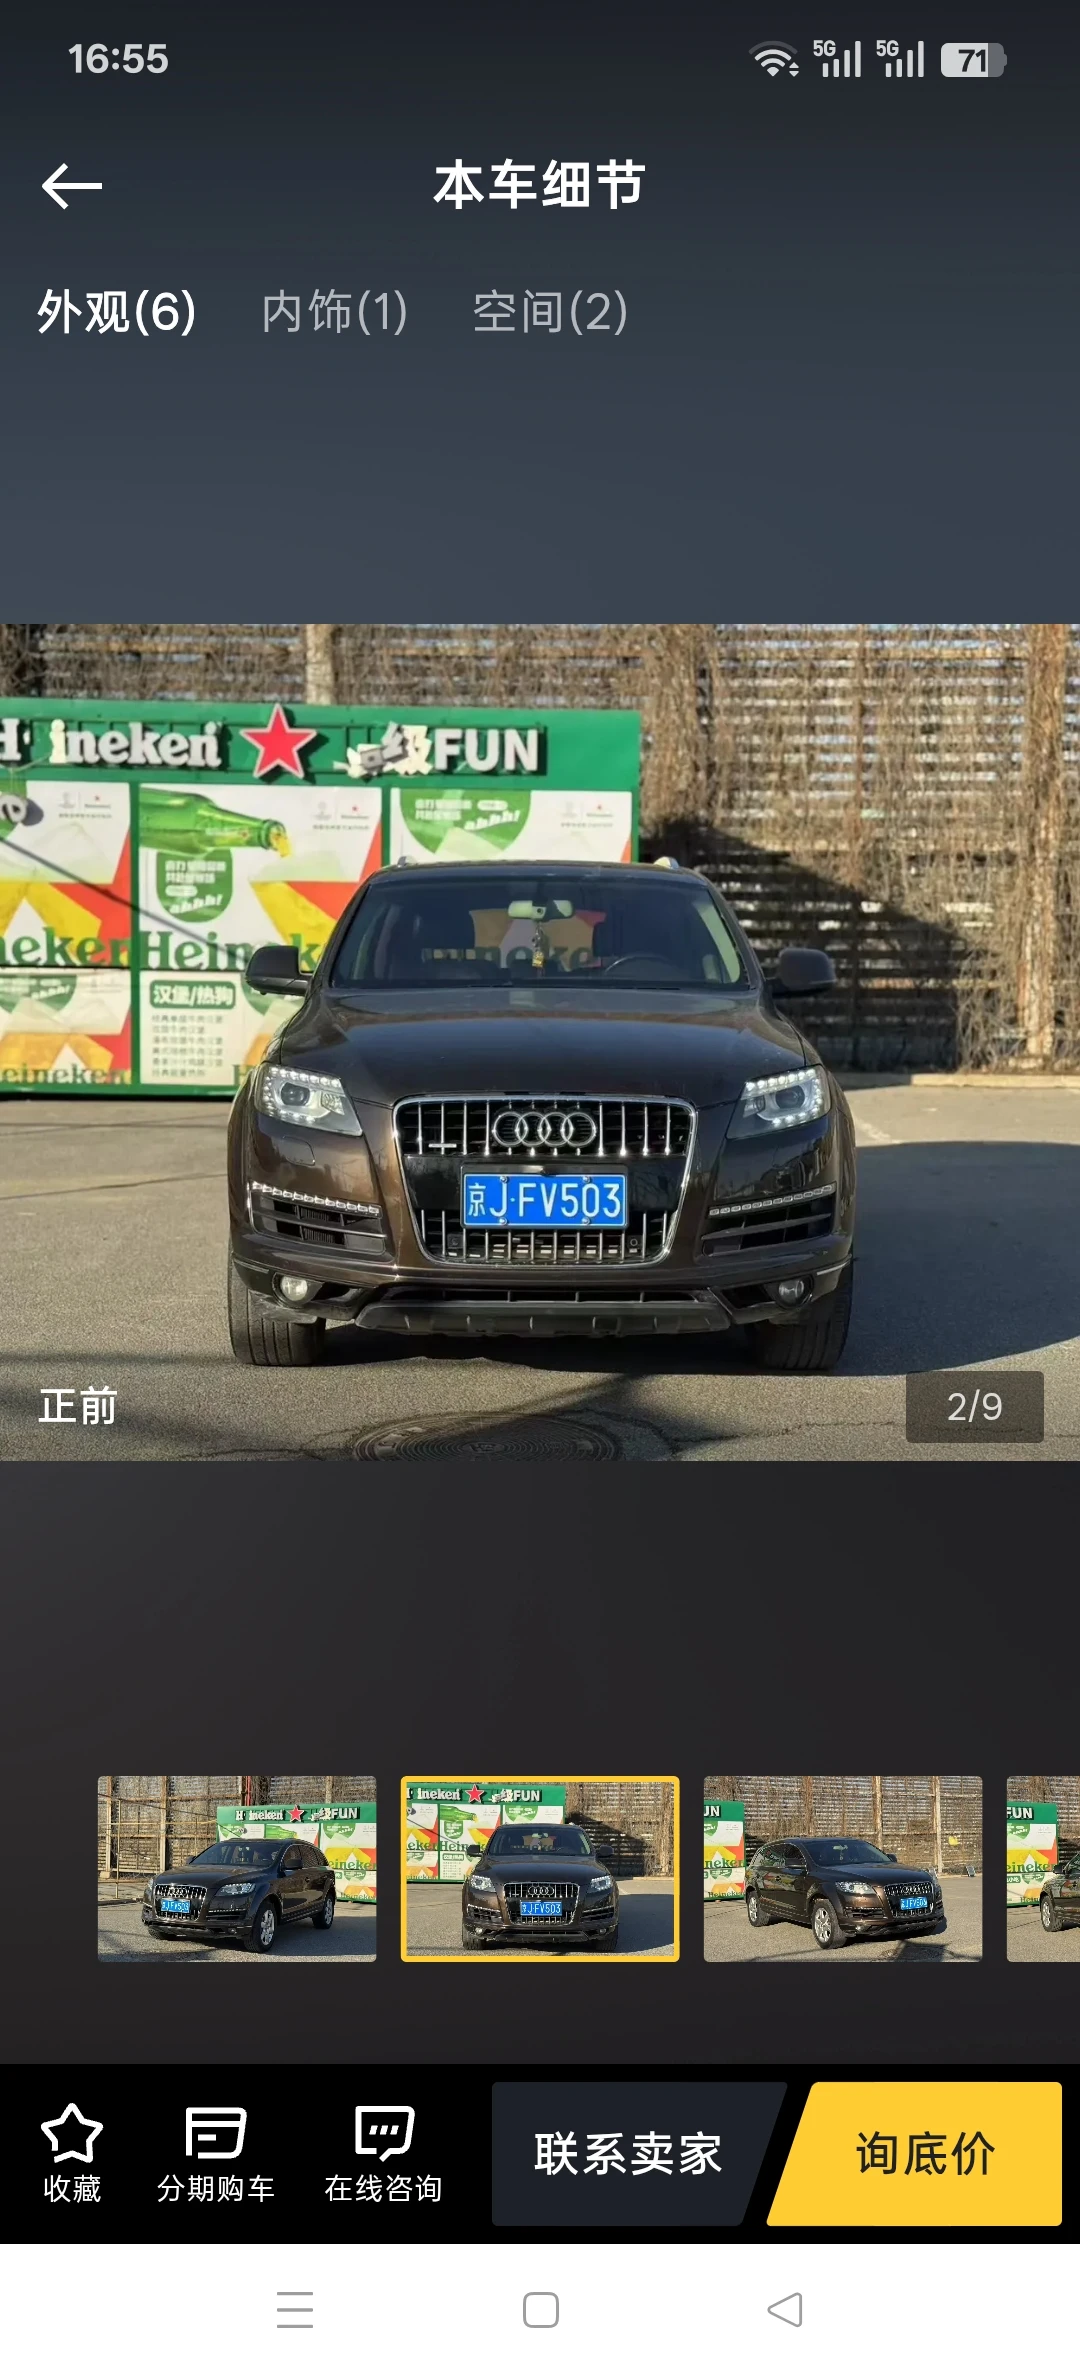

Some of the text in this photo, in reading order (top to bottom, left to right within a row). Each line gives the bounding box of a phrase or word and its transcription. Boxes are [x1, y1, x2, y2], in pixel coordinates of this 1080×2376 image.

[68, 43, 169, 74] 16:55
[813, 39, 837, 57] 5G
[876, 39, 900, 57] 5G
[957, 49, 987, 73] 71
[433, 158, 646, 210] 本车细节
[36, 288, 196, 337] 外观(6)
[262, 288, 408, 337] 内饰(1)
[472, 288, 628, 337] 空间(2)
[533, 2130, 723, 2176] 联系卖家
[856, 2130, 996, 2176] 询底价
[43, 2174, 102, 2204] 收藏
[157, 2173, 275, 2204] 分期购车
[324, 2173, 442, 2204] 在线咨询
